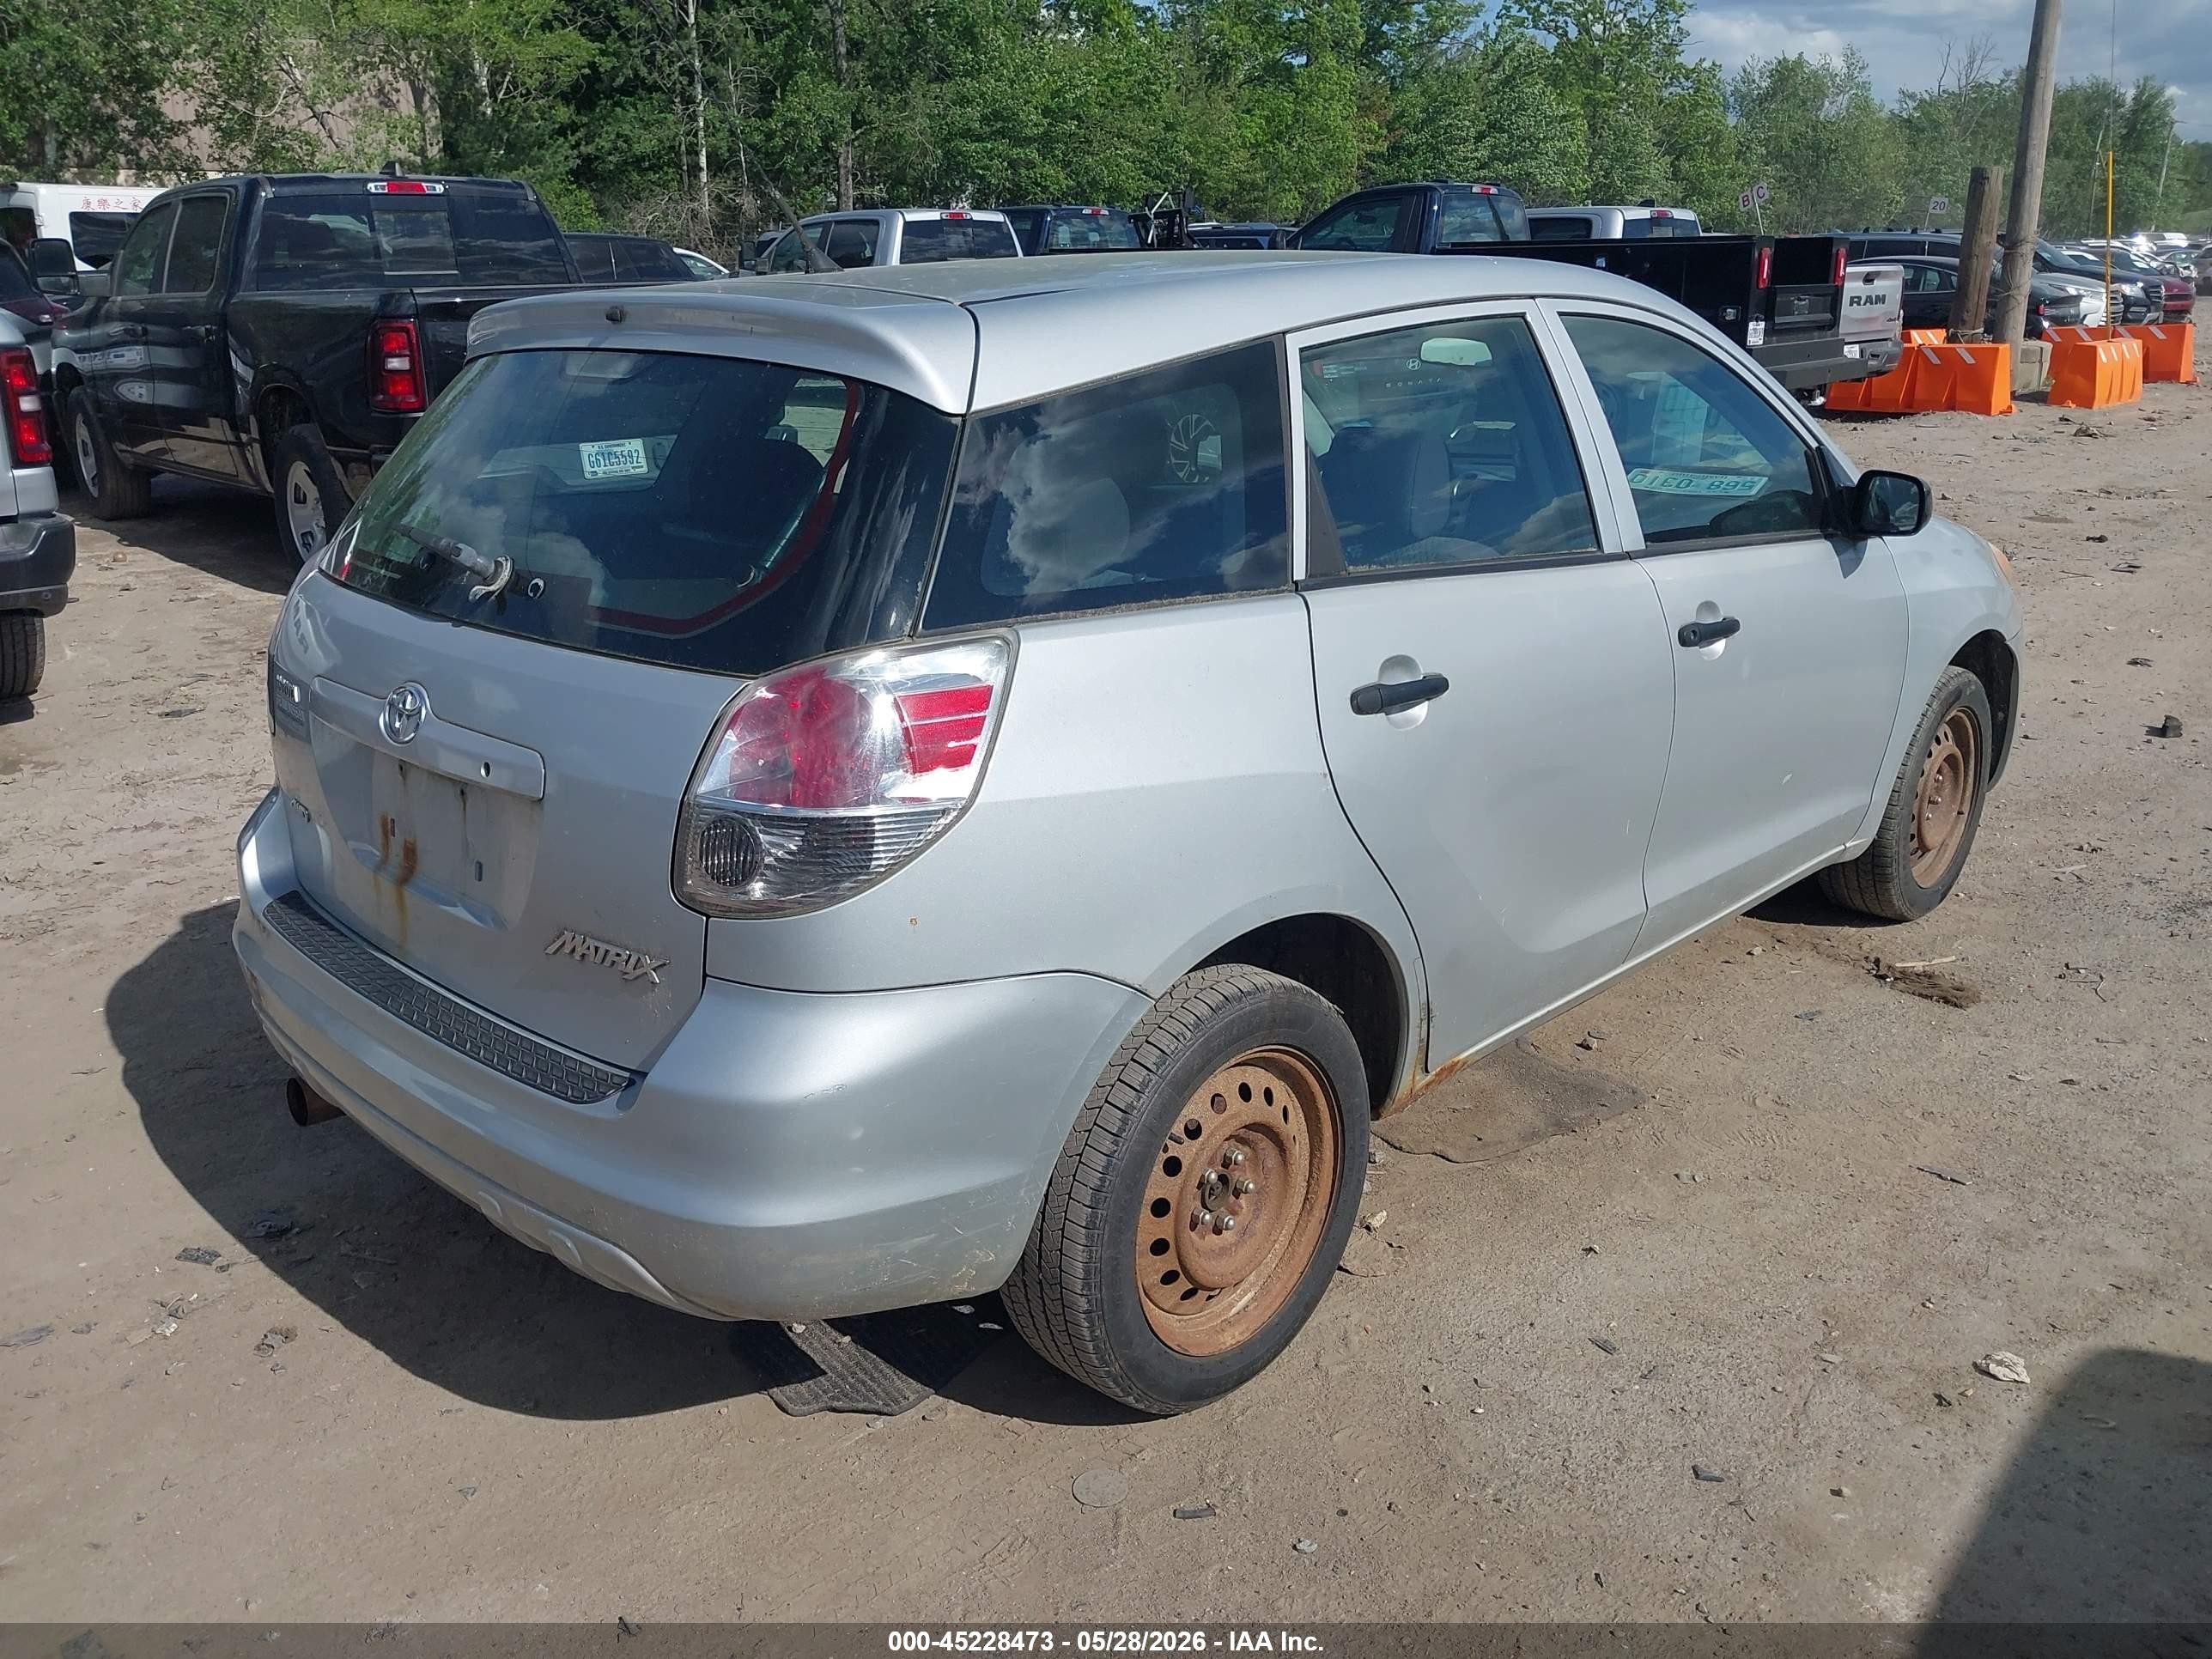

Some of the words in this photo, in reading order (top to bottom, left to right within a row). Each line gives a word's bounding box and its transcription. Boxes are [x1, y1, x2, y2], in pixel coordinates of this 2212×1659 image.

[1756, 185, 1765, 199] C
[1741, 194, 1750, 208] B
[1932, 200, 1946, 211] 20
[1848, 294, 1887, 307] RAM
[544, 929, 671, 984] MATRIX
